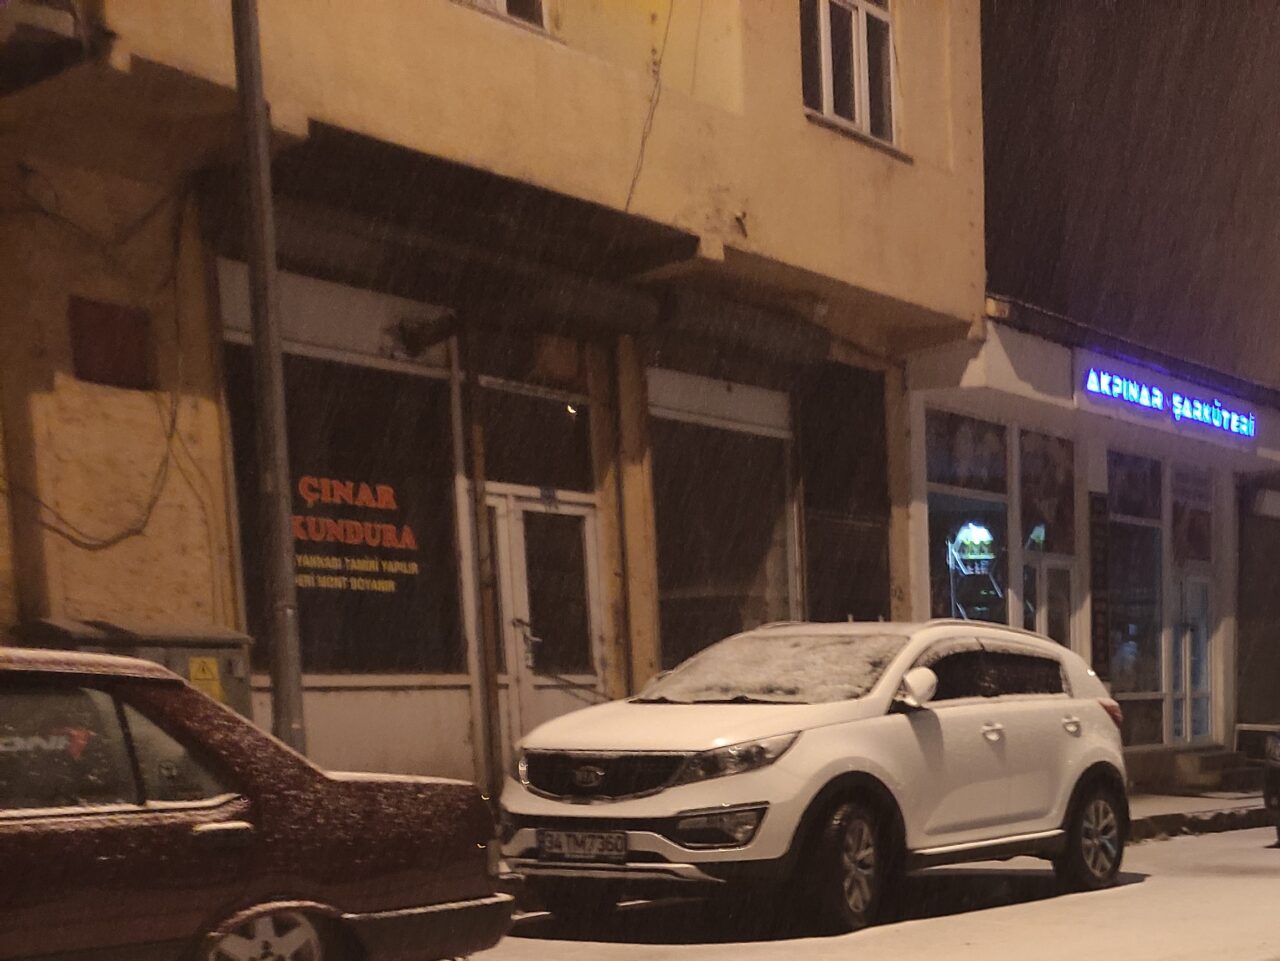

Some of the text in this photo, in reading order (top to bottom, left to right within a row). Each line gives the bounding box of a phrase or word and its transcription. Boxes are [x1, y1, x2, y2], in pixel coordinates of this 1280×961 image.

[1086, 368, 1255, 437] AKPINAR ŞARKÜTERİ
[298, 476, 398, 509] ÇINAR
